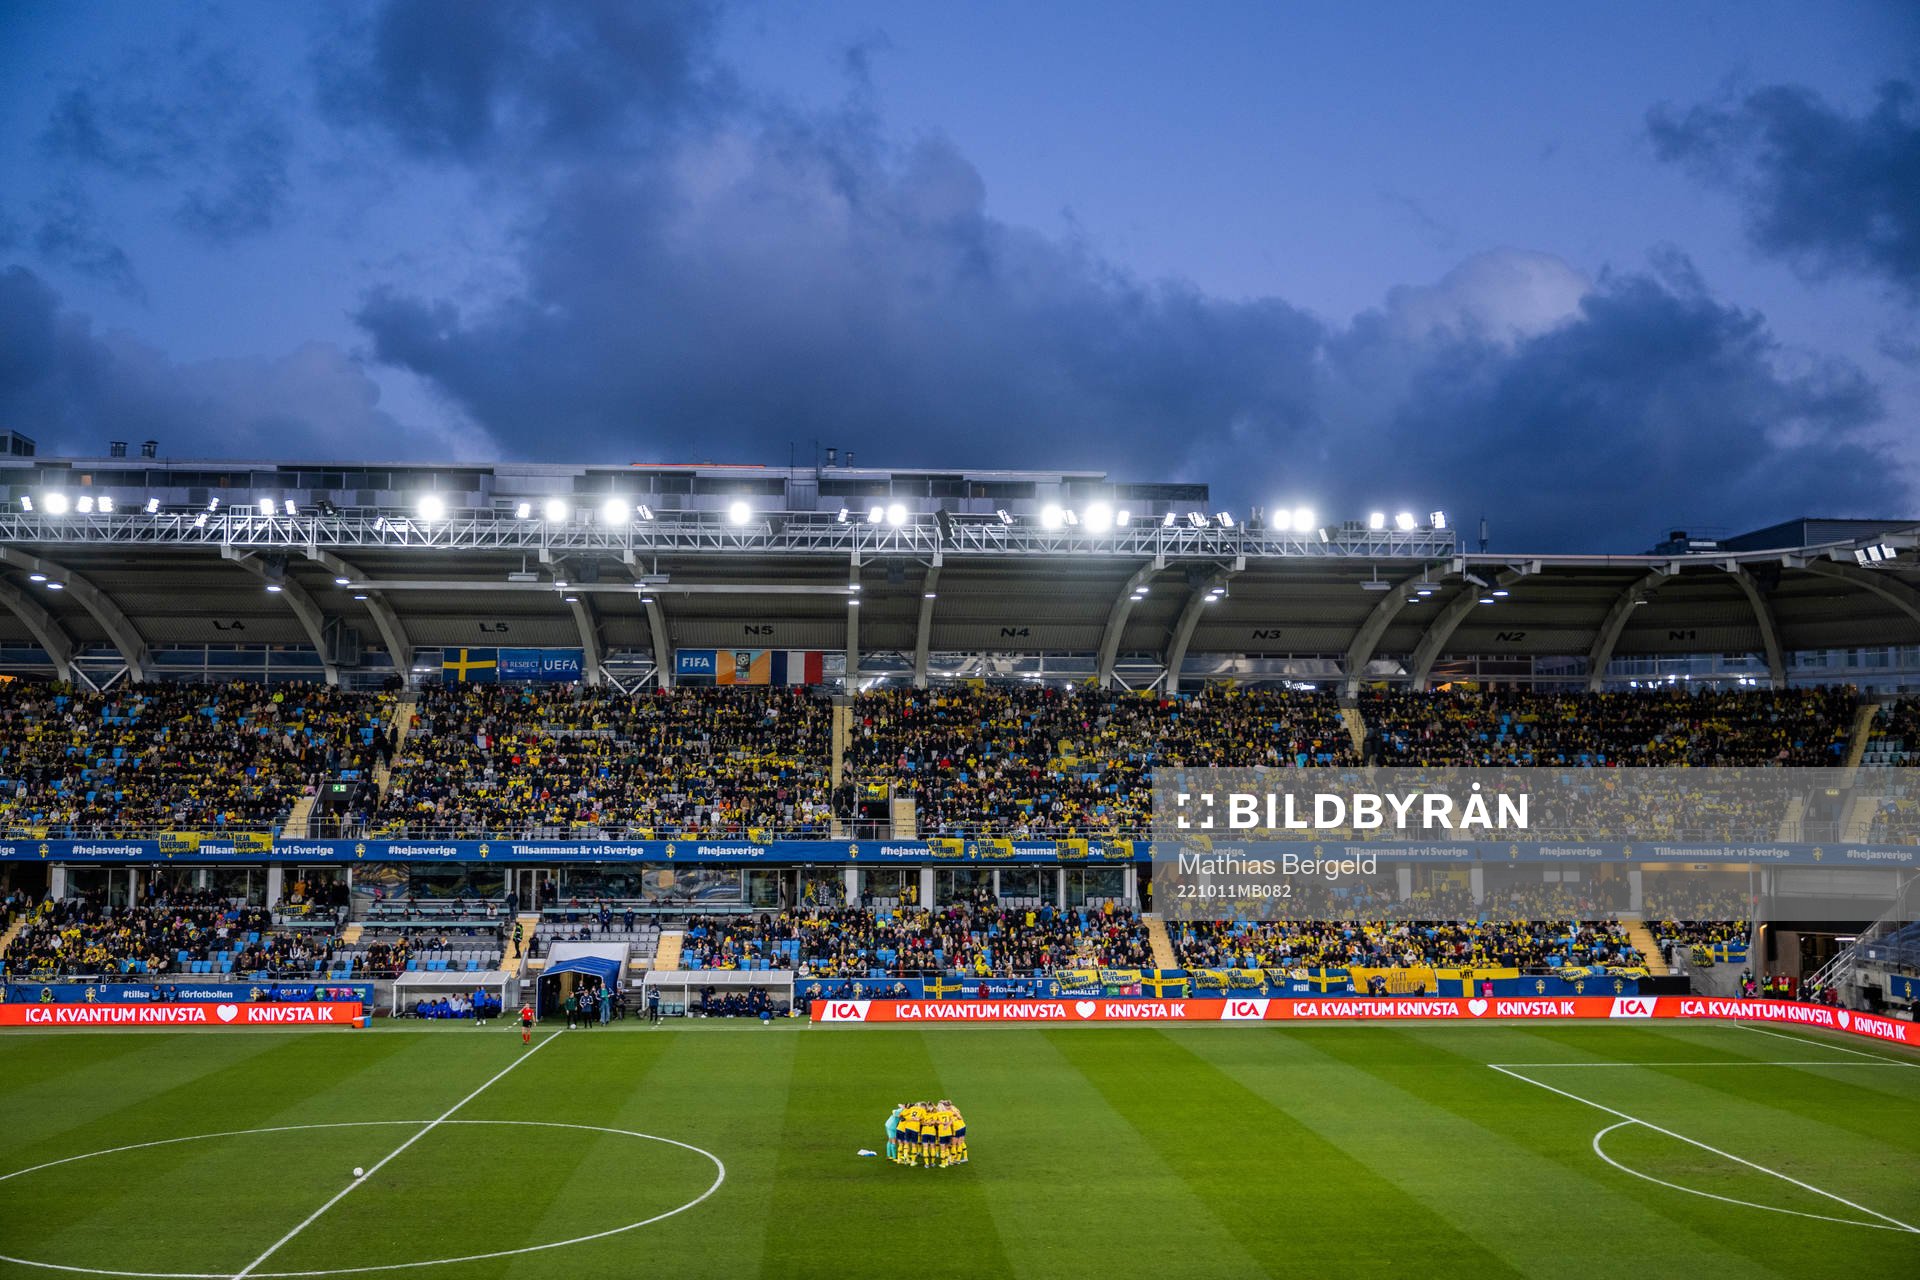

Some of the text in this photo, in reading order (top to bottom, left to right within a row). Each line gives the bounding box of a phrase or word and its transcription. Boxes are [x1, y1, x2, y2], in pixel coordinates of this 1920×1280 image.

[479, 622, 509, 633] L5
[744, 625, 774, 636] N5
[1000, 627, 1030, 637] N4
[1252, 630, 1281, 640] N3
[1495, 631, 1526, 642] N2
[544, 660, 578, 671] UEFA
[682, 657, 710, 668] FIFA
[72, 845, 143, 857] #hejasverige
[200, 845, 237, 855] Tillsam
[281, 845, 292, 855] vi
[293, 845, 334, 857] Sverige
[388, 845, 457, 857] #hejasverige
[512, 845, 644, 857] Tillsammans är vi Sverige
[697, 846, 765, 857] #hejasverige
[880, 846, 930, 857] #hejasver
[1343, 846, 1469, 858] Tillsammans är vi Sverige
[1539, 847, 1603, 858] #hejasverige
[1653, 847, 1790, 859] Tillsammans är vi Sverige
[1846, 849, 1913, 861] #hejasverige
[832, 1003, 861, 1018] ICA
[896, 1003, 1185, 1018] ICA KVANTUM KNIVSTA KNIVSTA IK
[1232, 1001, 1260, 1017] ICA
[1293, 1001, 1575, 1016] ICA KVANTUM KNIVSTA KNIVSTA IK
[1620, 1000, 1648, 1015] ICA
[26, 1006, 333, 1023] ICA KVANTUM KNIVSTA KNIVSTA IK
[1681, 1001, 1906, 1041] ICA KVANTUM KNIVSTA KNIVSTA IK
